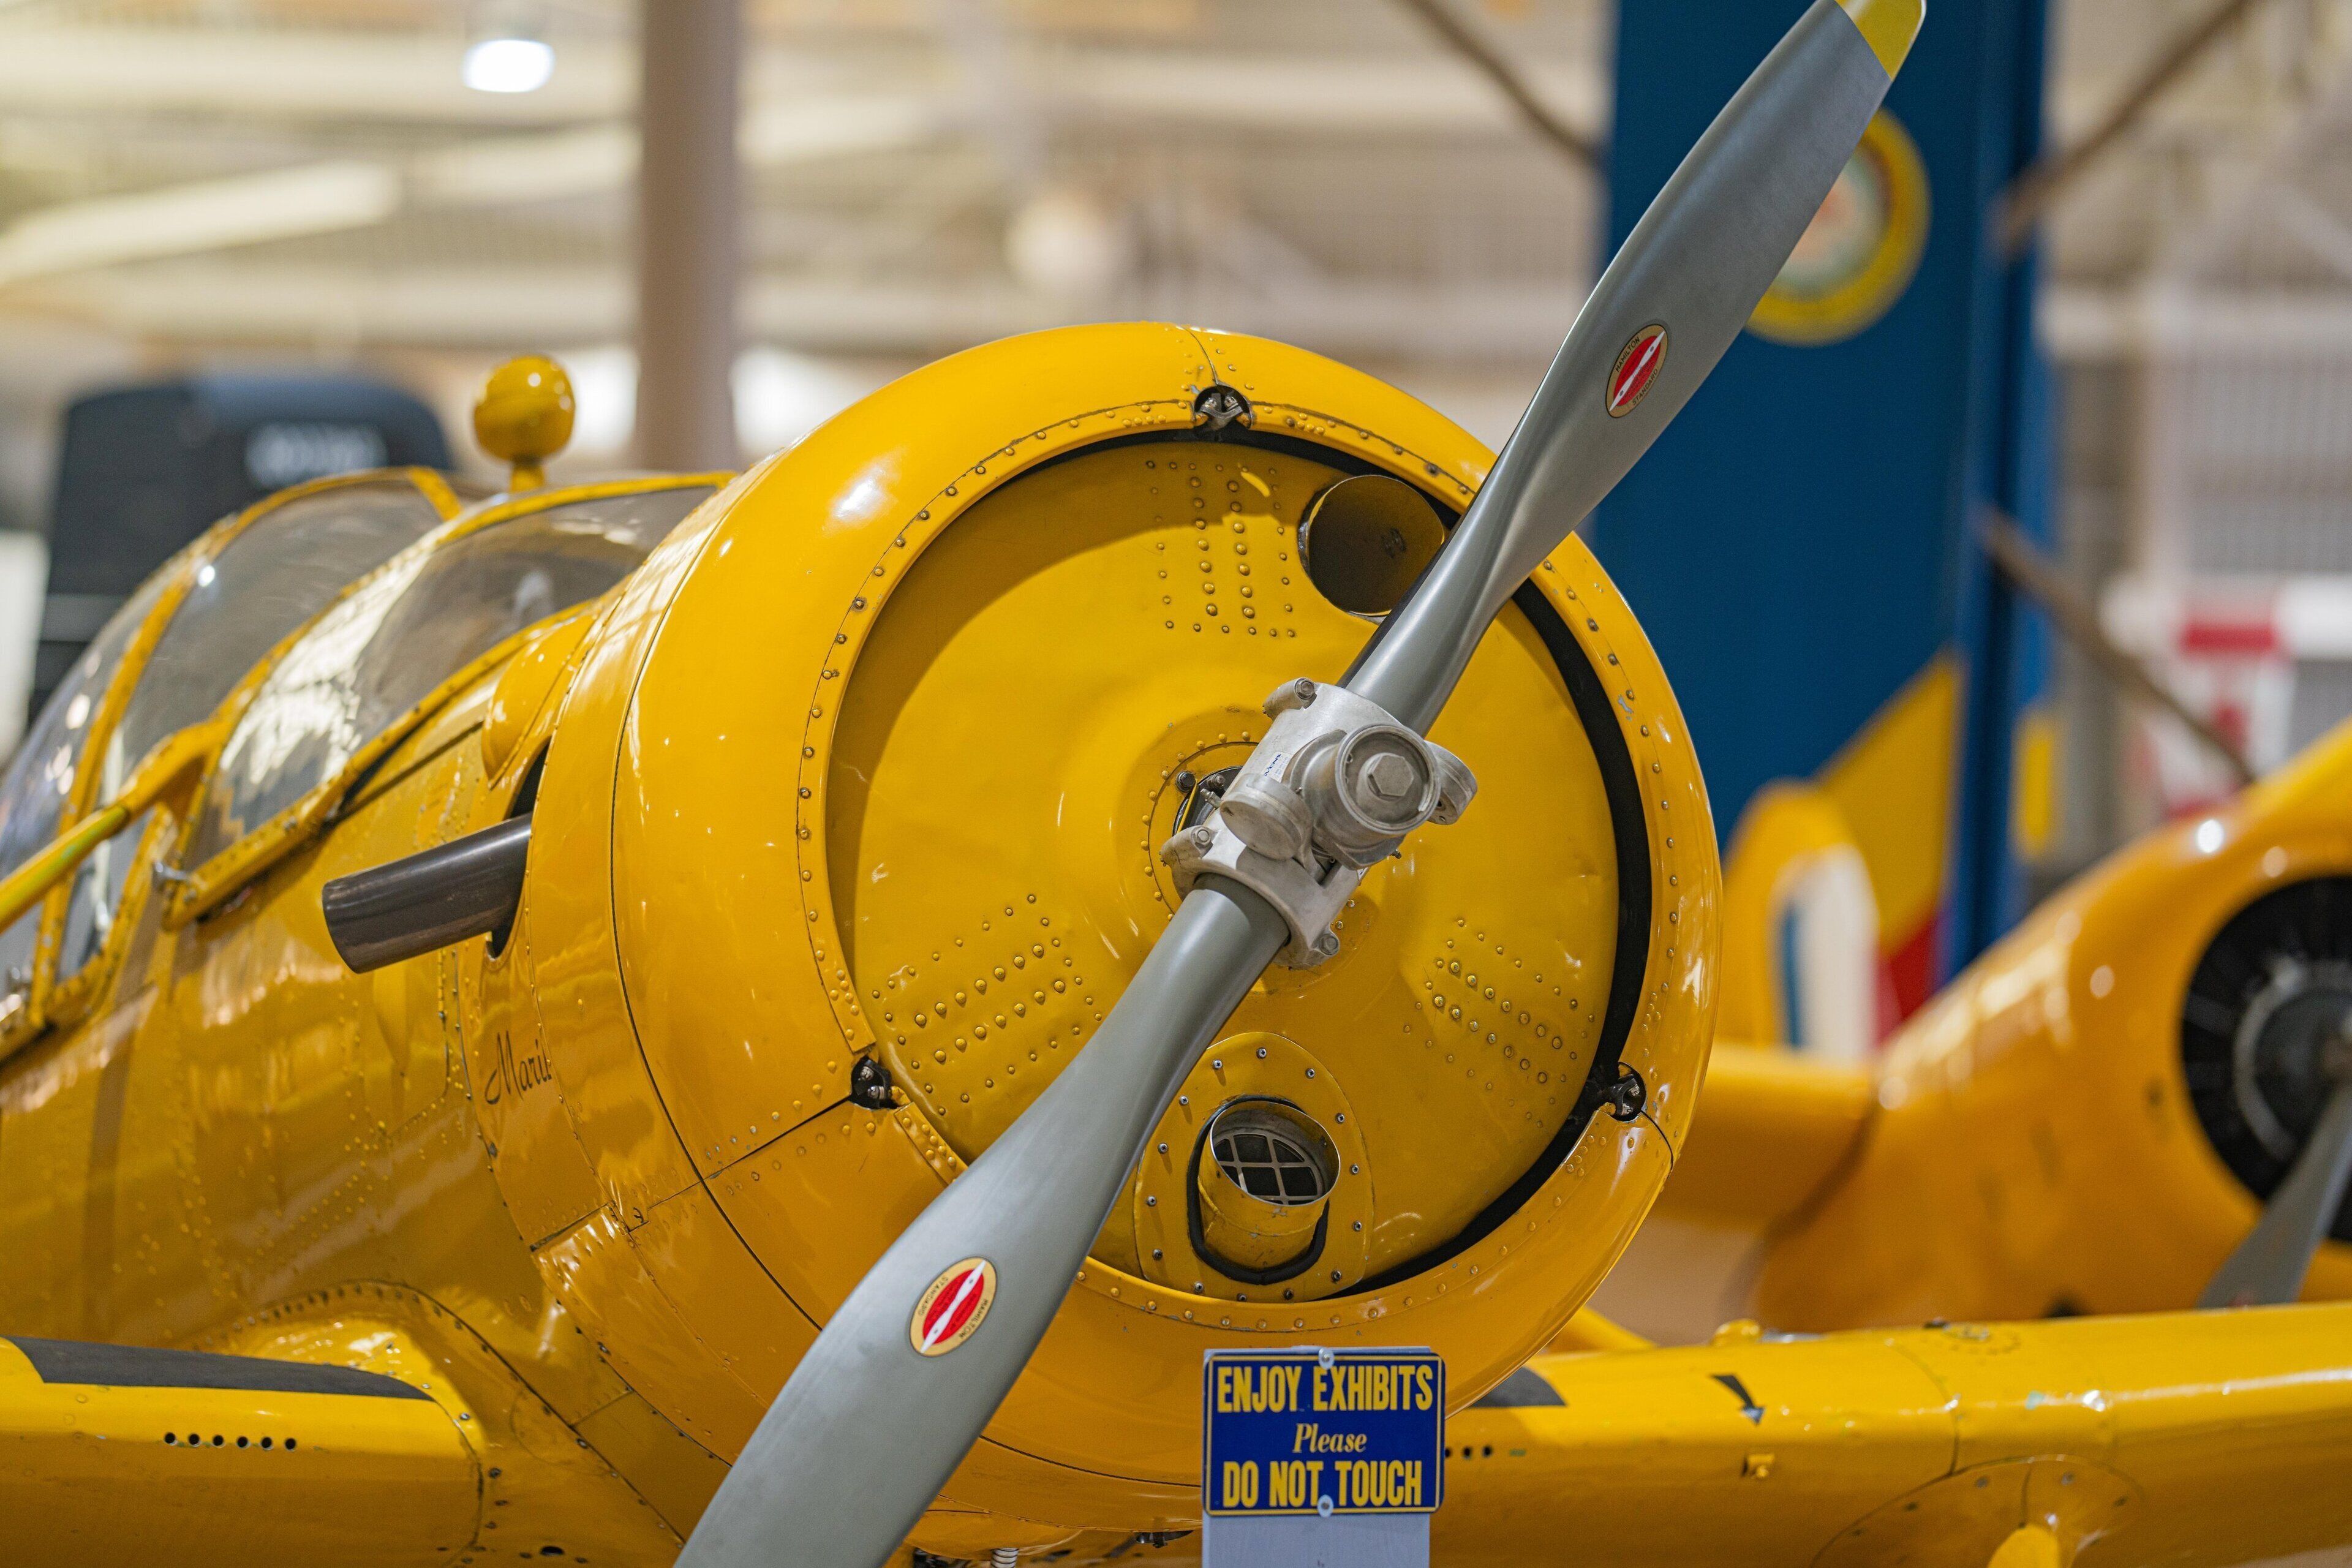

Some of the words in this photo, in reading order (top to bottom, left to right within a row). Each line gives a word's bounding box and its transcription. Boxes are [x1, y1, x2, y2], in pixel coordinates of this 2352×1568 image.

[1615, 336, 1640, 372] HAMILTON
[1632, 368, 1659, 405] STANDARD
[918, 1275, 948, 1316] STANDARD
[959, 1298, 989, 1339] HAMILTON
[1216, 1365, 1302, 1413] ENJOY
[1313, 1364, 1433, 1412] EXHIBITS
[1292, 1422, 1368, 1453] Please
[1223, 1460, 1259, 1508] DO
[1268, 1460, 1324, 1508] NOT
[1334, 1460, 1423, 1507] TOUCH
